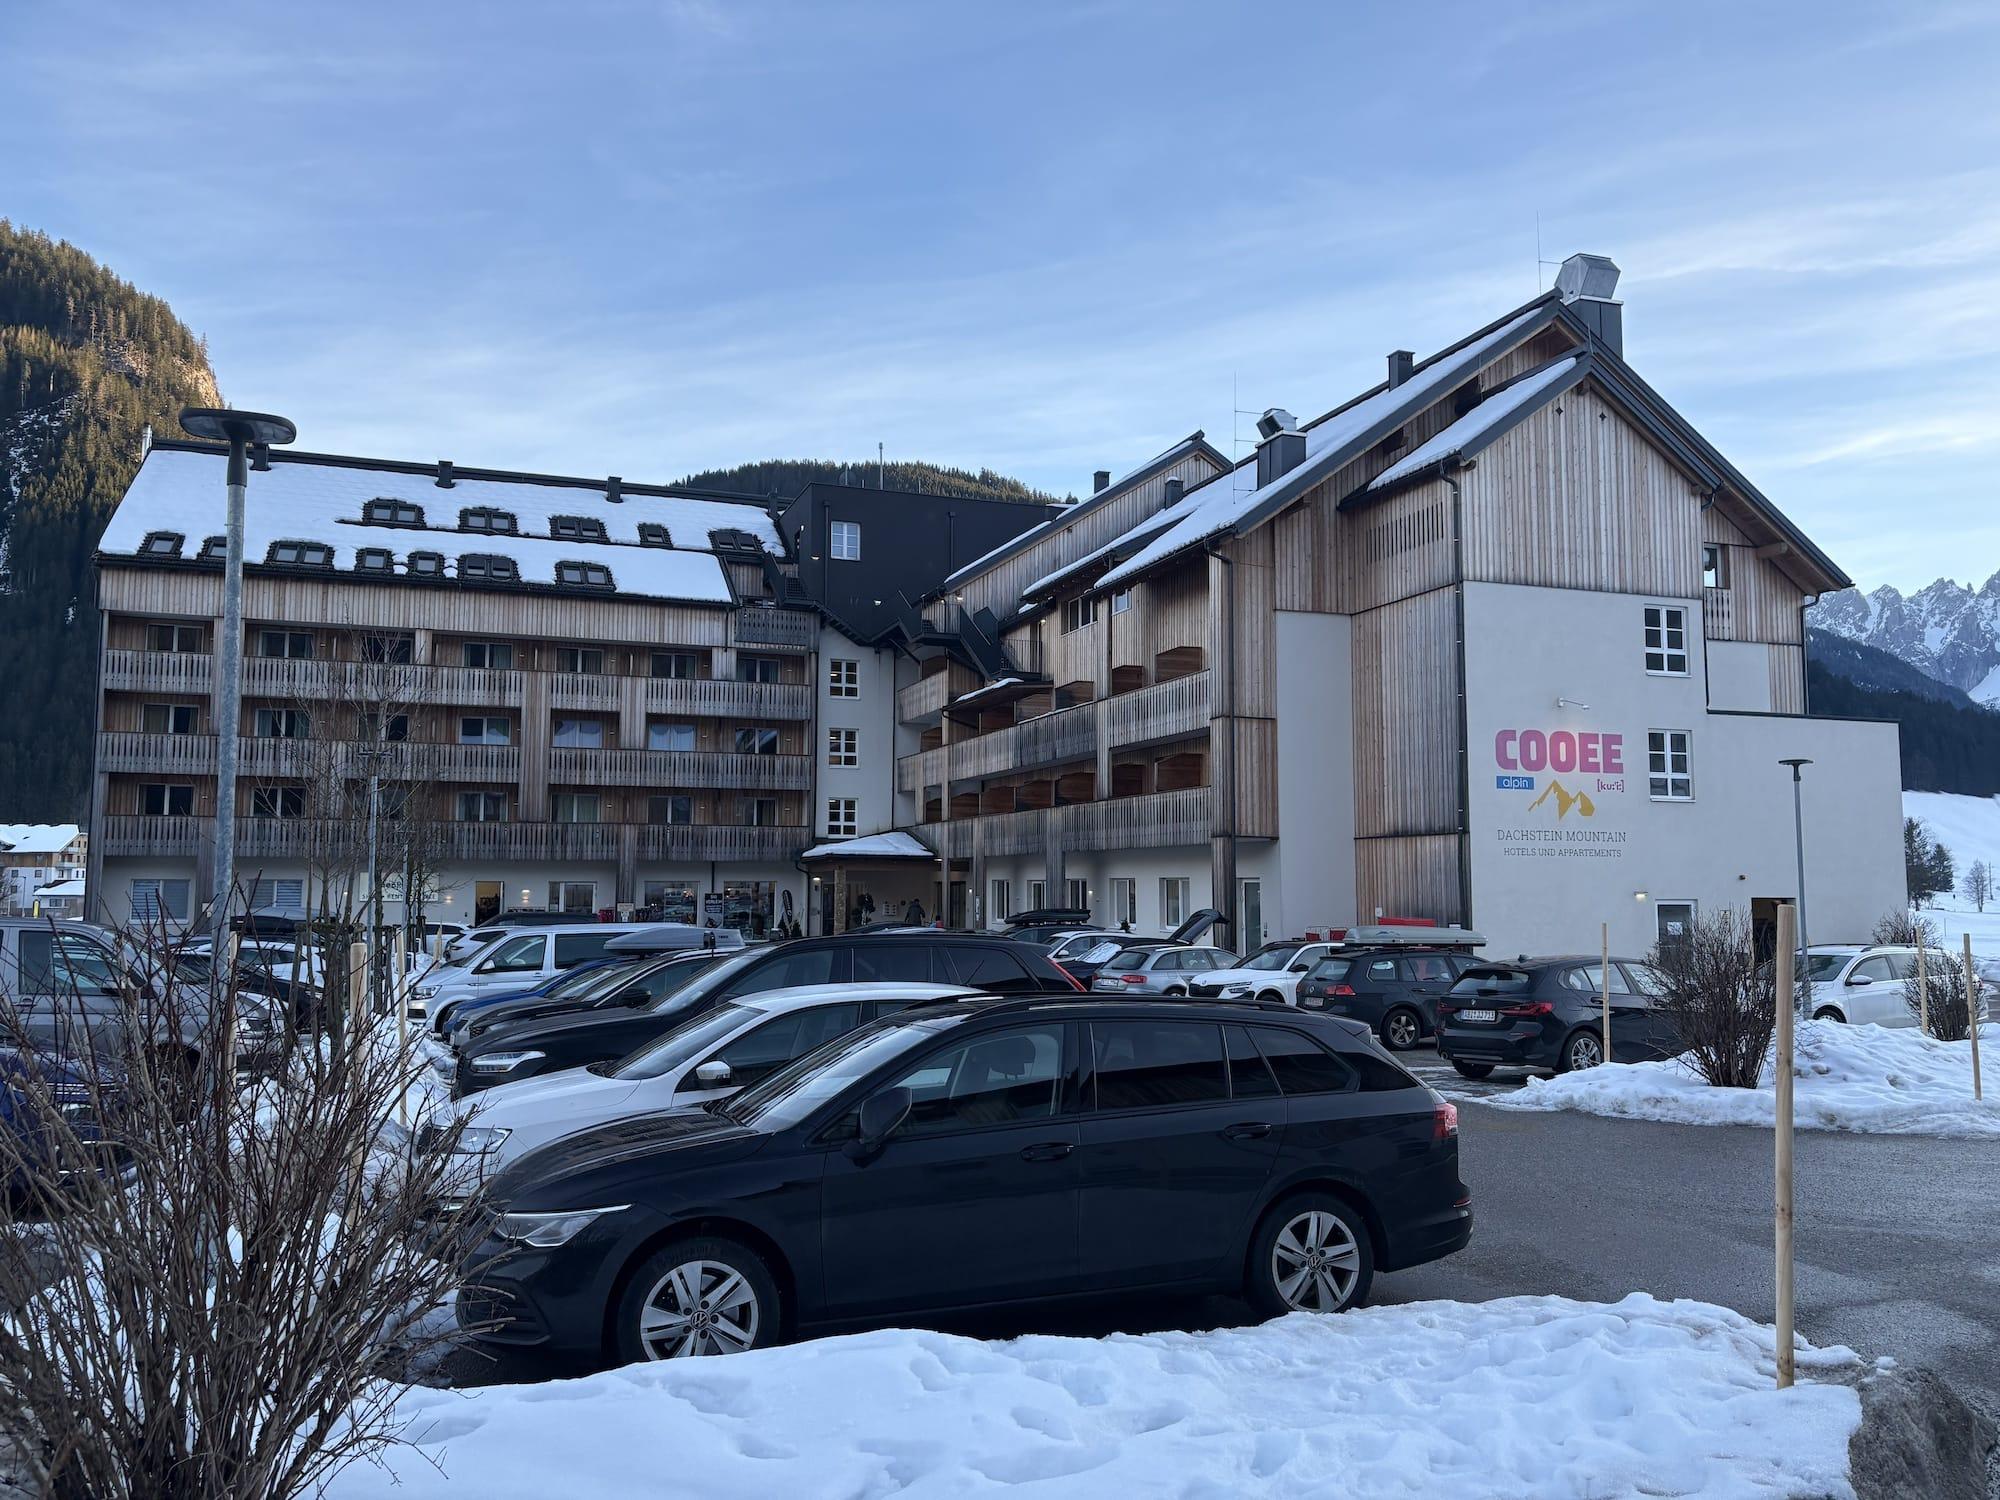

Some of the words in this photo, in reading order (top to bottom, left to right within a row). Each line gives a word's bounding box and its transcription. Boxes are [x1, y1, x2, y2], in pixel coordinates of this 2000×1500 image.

[1495, 729, 1624, 774] COOEE
[1502, 776, 1529, 790] alpin
[1497, 829, 1563, 841] DACHSTEIN
[1566, 831, 1626, 843] MOUNTAIN
[1503, 847, 1537, 857] HOTELS
[1538, 848, 1556, 857] UND
[1558, 848, 1622, 858] APPARTEMENTS
